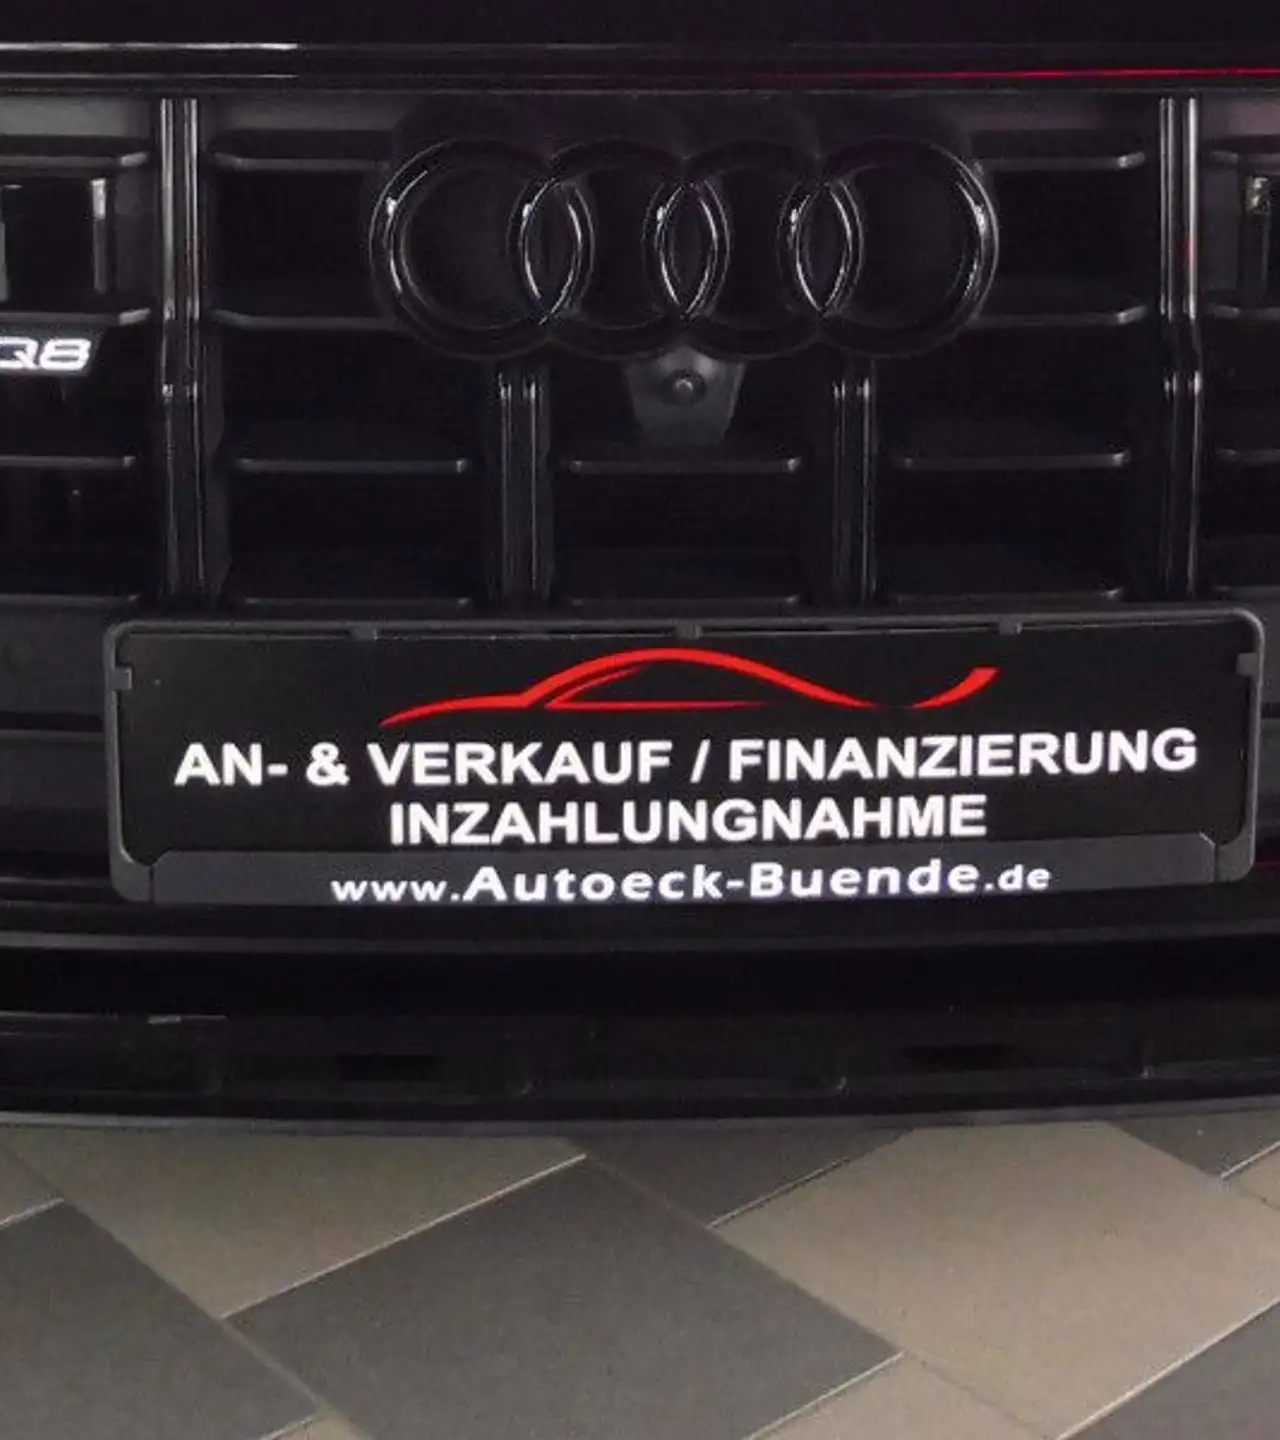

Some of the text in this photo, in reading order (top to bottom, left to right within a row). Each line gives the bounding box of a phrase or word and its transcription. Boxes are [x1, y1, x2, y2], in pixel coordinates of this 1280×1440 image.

[174, 727, 1198, 787] AN- & VERKAUF / FINANZIERUNG
[390, 793, 988, 846] INZAHLUNGNAHME
[330, 858, 1053, 903] www.Autoeck-Buende.de
